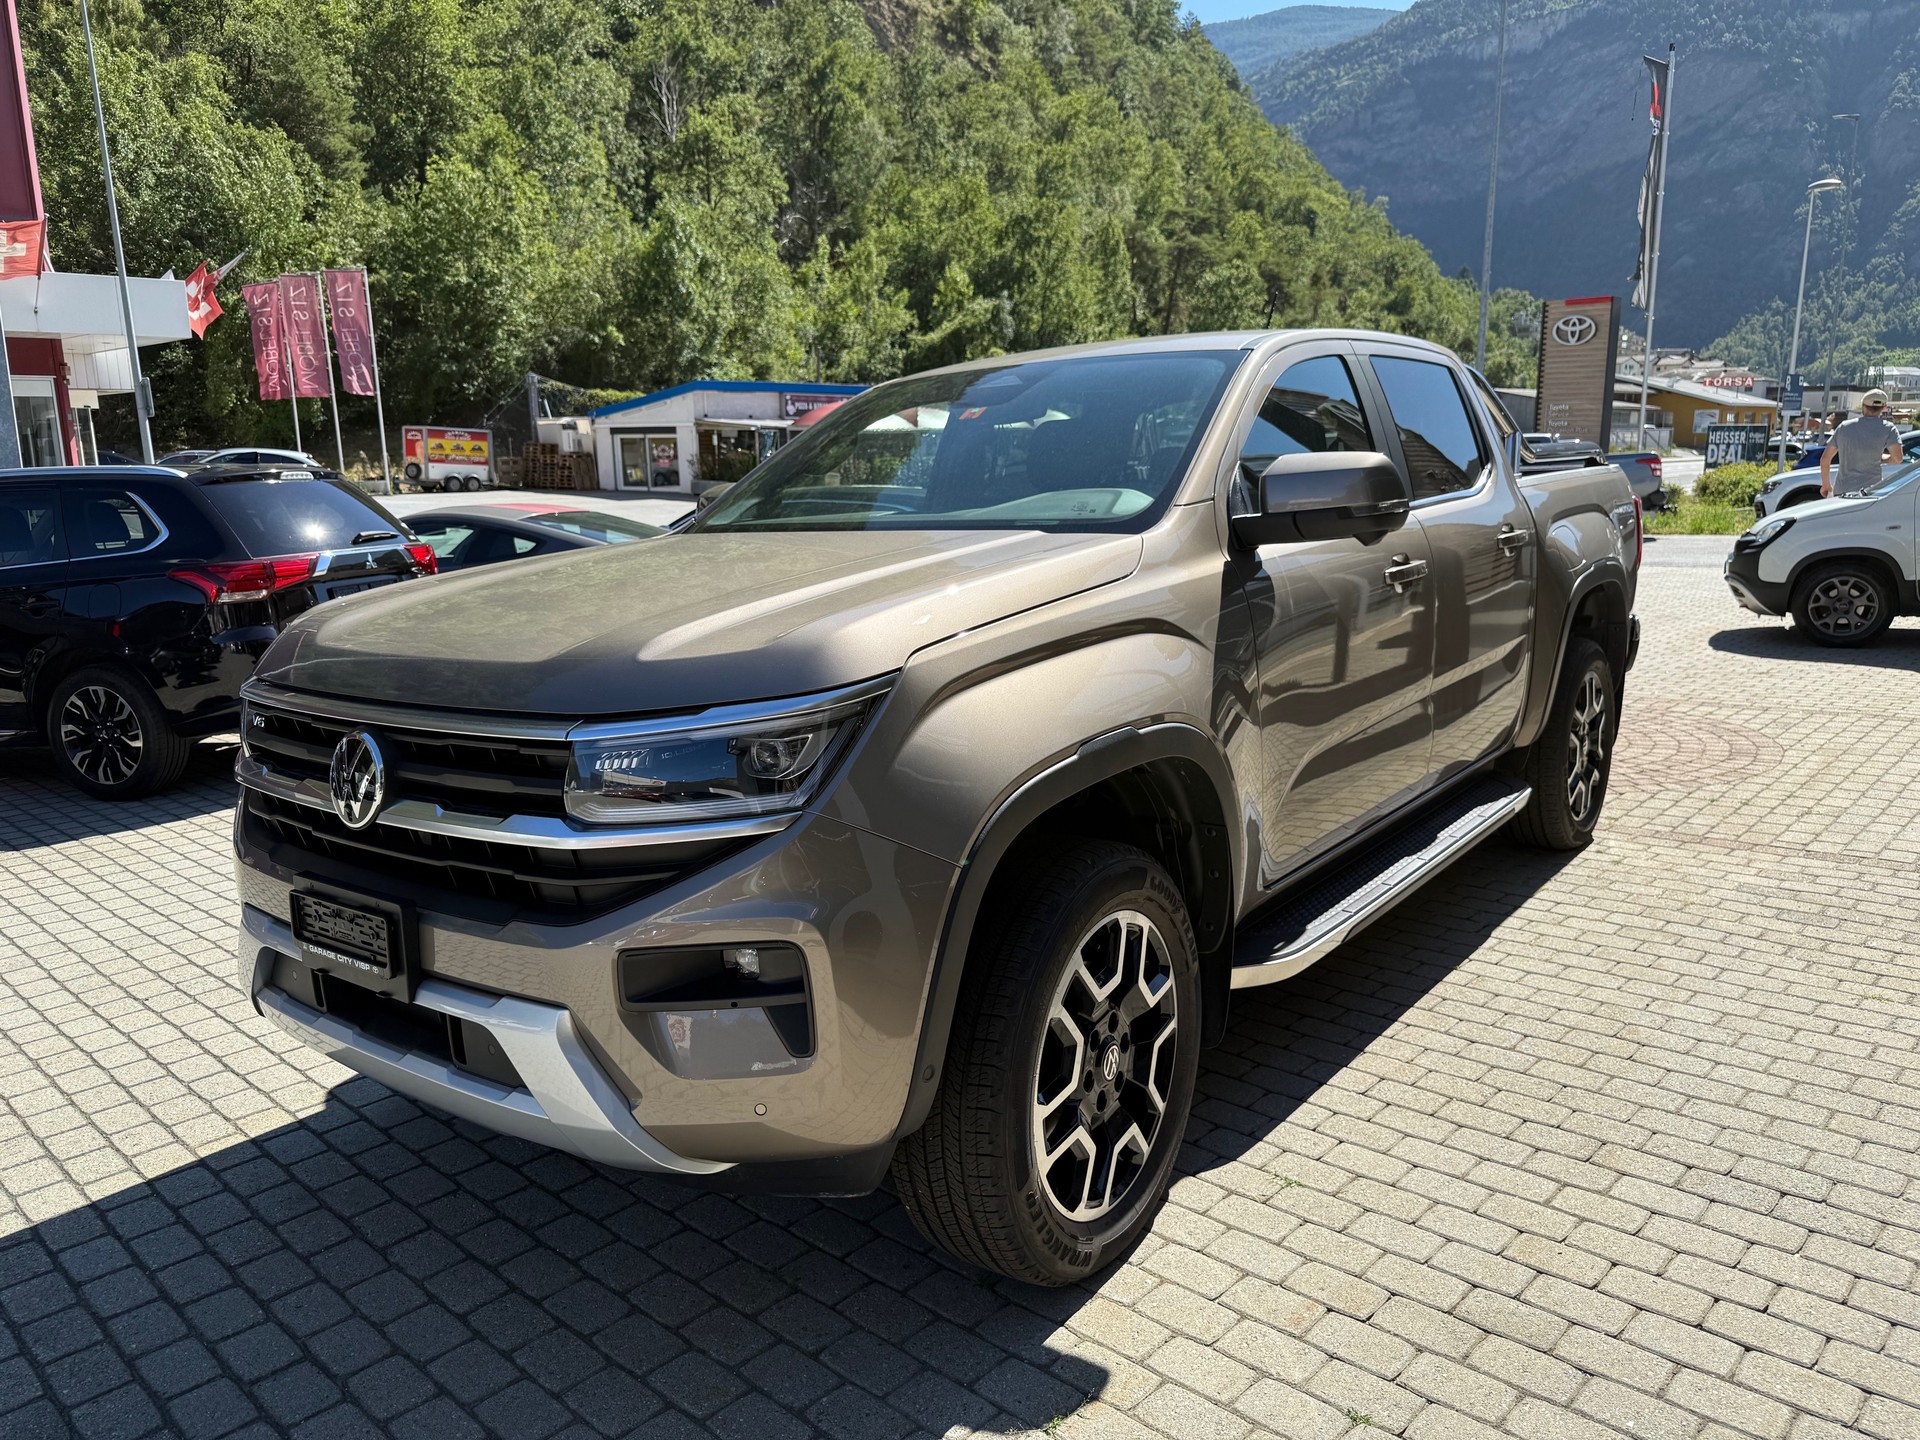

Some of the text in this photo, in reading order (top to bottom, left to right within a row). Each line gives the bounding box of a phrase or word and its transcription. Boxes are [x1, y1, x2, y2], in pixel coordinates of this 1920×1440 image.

[1702, 376, 1754, 387] TORSA
[1708, 430, 1746, 445] HEISSER
[252, 714, 265, 728] V6
[308, 944, 370, 971] GARAGE CITY VISP
